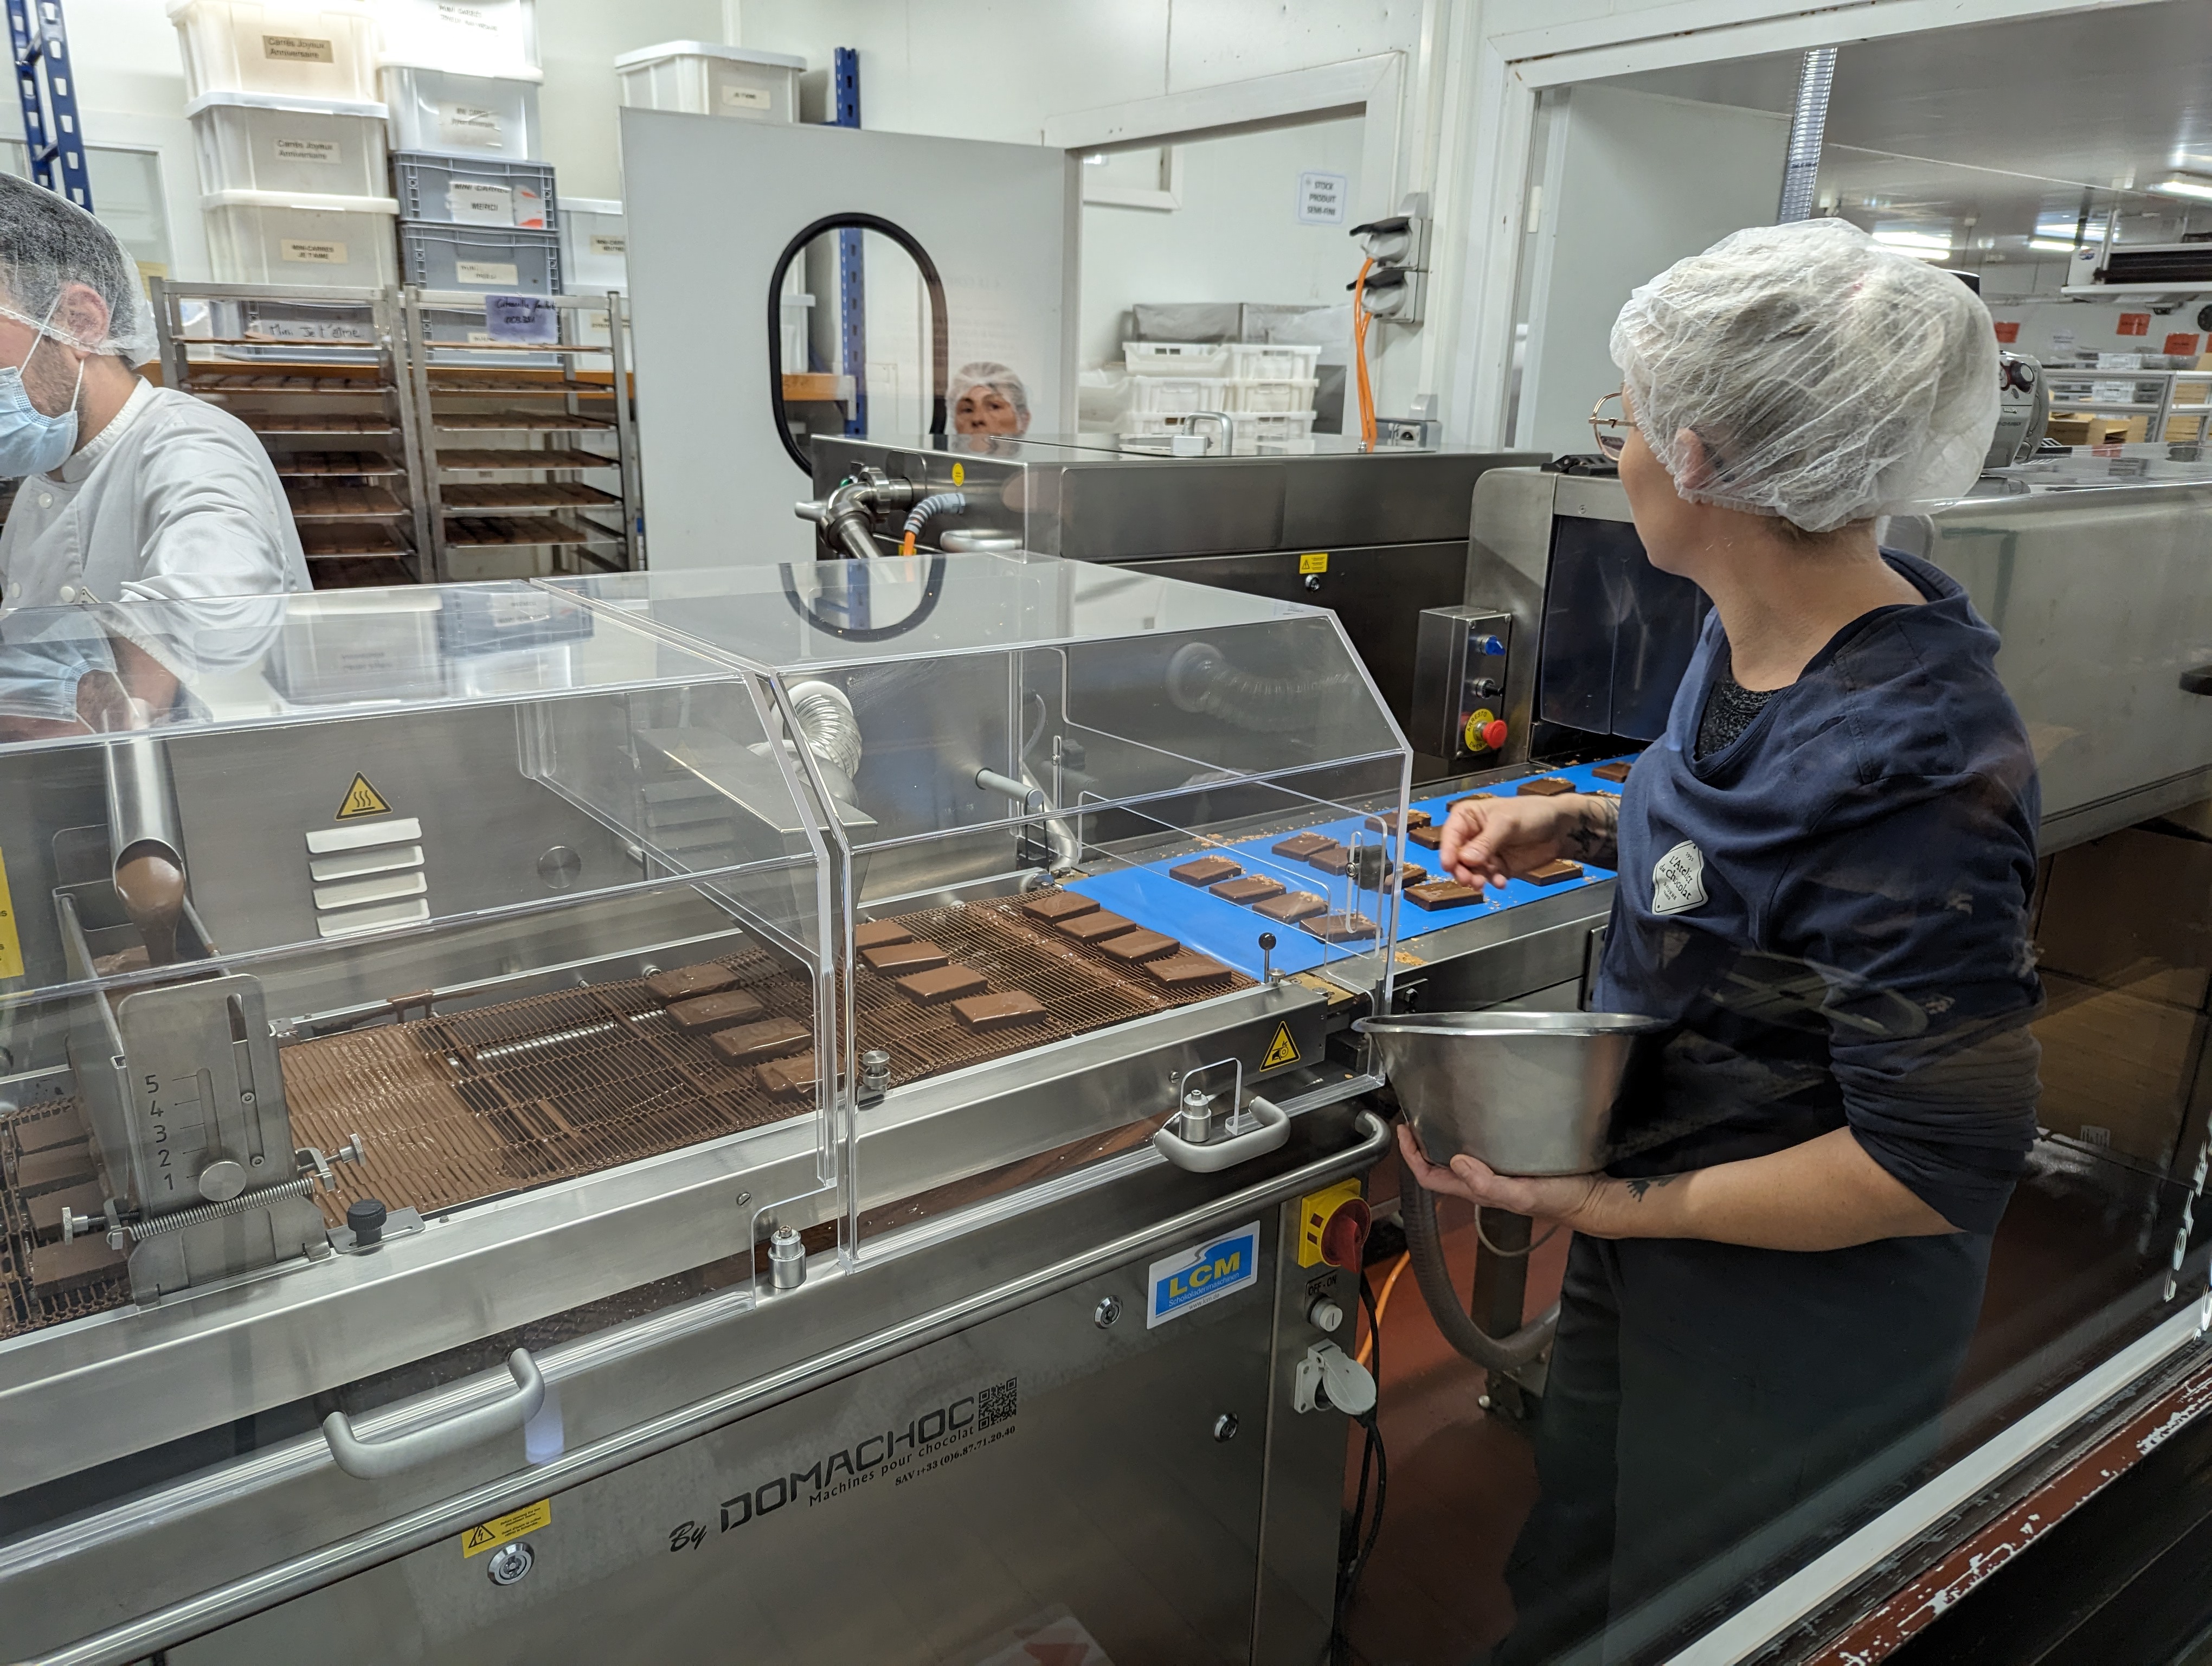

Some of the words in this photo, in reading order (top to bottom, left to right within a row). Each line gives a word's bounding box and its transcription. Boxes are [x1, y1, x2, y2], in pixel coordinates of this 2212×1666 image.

[1314, 181, 1335, 190] STOCK
[1309, 193, 1336, 203] PRODUIT
[1467, 711, 1487, 732] ARRESTO
[1669, 856, 1693, 884] L'Atelier
[1659, 864, 1666, 873] du
[1666, 869, 1692, 900] Chocolat
[145, 1074, 159, 1093] 5
[150, 1100, 164, 1117] 4
[153, 1124, 167, 1143] 3
[158, 1149, 171, 1167] 2
[164, 1174, 173, 1190] 1
[1169, 1251, 1240, 1298] LCM
[1169, 1272, 1239, 1306] Schokoladenmaschinen
[1308, 1281, 1322, 1296] OFF
[1327, 1274, 1336, 1286] ON
[1189, 1293, 1220, 1310] www.lcm.de
[669, 1521, 707, 1552] By
[721, 1396, 974, 1533] DOMACHOC
[809, 1471, 874, 1507] Machines
[882, 1454, 912, 1476] pour
[918, 1426, 974, 1457] chocolat
[895, 1470, 915, 1486] SAV
